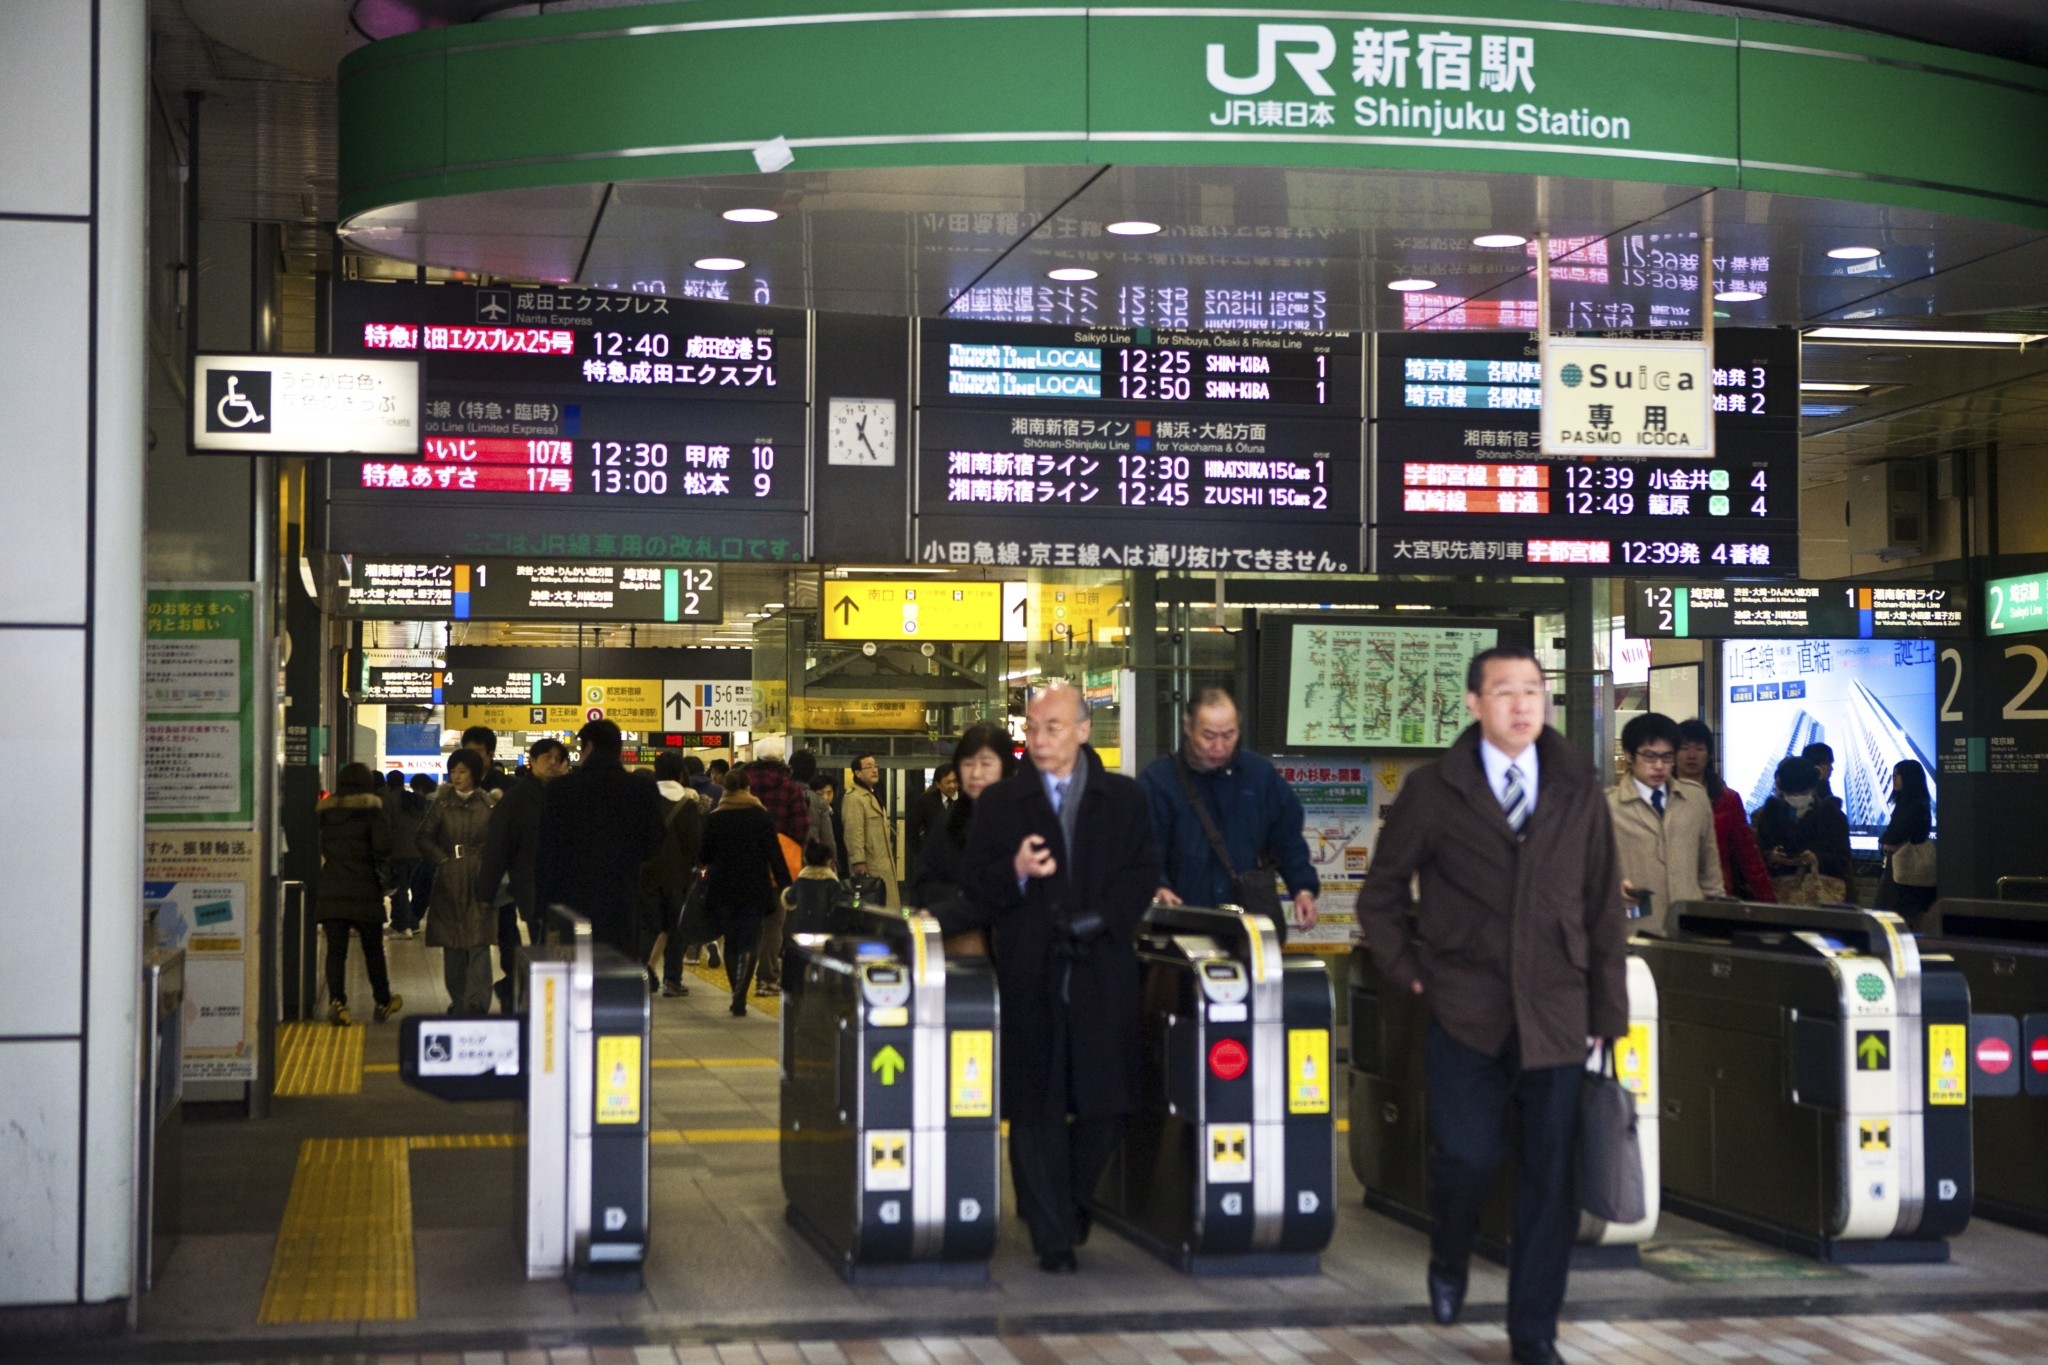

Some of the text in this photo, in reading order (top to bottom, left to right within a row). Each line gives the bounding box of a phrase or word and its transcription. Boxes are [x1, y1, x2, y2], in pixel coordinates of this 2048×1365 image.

[1206, 24, 1337, 97] JR
[1351, 27, 1537, 95] 新宿駅
[1210, 100, 1335, 128] JR東日本
[1354, 95, 1631, 140] Shinjuku Station
[516, 293, 670, 315] 成田エクスプレス
[516, 314, 593, 327] Narita Express
[593, 332, 669, 357] 12:40
[686, 336, 753, 360] 成田空港
[757, 338, 772, 360] 5
[1075, 332, 1131, 344] Saikyō Line
[1157, 336, 1302, 349] for Shibuya, Ōsaki & Rinkai Line
[949, 344, 1017, 357] Through To
[1003, 356, 1036, 369] LINE
[1036, 349, 1325, 378] LOCAL 12:25 SHIN-KIBA 1
[1405, 359, 1467, 381] 埼京線
[1752, 367, 1766, 389] 3
[949, 370, 1017, 384] Through To
[1590, 364, 1694, 391] Suica
[1003, 383, 1036, 396] LINE
[1036, 375, 1325, 404] LOCAL 12:50 SHIN-KIBA 1
[1405, 385, 1467, 408] 埼京線
[1751, 393, 1766, 414] 2
[442, 422, 559, 435] Line (Limited Express)
[1011, 418, 1266, 441] 湘南新宿ライン 横浜・大船方面
[1561, 430, 1690, 446] PASMO ICOCA
[427, 440, 774, 470] いじ 107号 12:30 甲府 10
[1023, 438, 1130, 452] Shōnan-Shinjuku Line
[1156, 442, 1265, 454] for Yokohama & Ōfuna
[948, 451, 1099, 476] 湘南新宿ライン
[1118, 455, 1190, 480] 12:30
[1204, 460, 1268, 479] HIRATSUKA
[1315, 460, 1324, 483] 1
[1404, 464, 1767, 491] 宇都宮線 普通 12:39 小金井 4
[363, 463, 771, 497] 特急あずさ 17号 13:00 松本 9
[948, 478, 1099, 503] 湘南新宿ライン
[1118, 482, 1190, 507] 12:45
[1204, 486, 1263, 506] ZUSHI
[1312, 486, 1327, 510] 2
[1497, 491, 1539, 513] 普通
[1566, 492, 1634, 515] 12:49
[1751, 496, 1767, 517] 4
[464, 533, 801, 560] ここはJR線専用の改札口です。
[923, 541, 1348, 573] 小田急線・京王線へは通り抜けできません。
[1393, 540, 1524, 560] 大宮駅先着列車
[1527, 541, 1770, 565] 宇都宮線 12:39発 4番線
[475, 565, 486, 587] 1
[646, 582, 661, 590] Line
[1845, 588, 1854, 608] 1
[1873, 588, 1945, 601] 湘南新宿ライン
[2009, 581, 2040, 602] 埼京線
[684, 592, 700, 615] 2
[1990, 585, 2004, 630] 2
[2030, 605, 2043, 616] Line
[1658, 610, 1673, 630] 2
[1730, 645, 1775, 679] 山手線
[1798, 640, 1831, 674] 直結
[443, 672, 454, 685] 4
[1940, 648, 1963, 722] 2
[2002, 644, 2048, 720] 2
